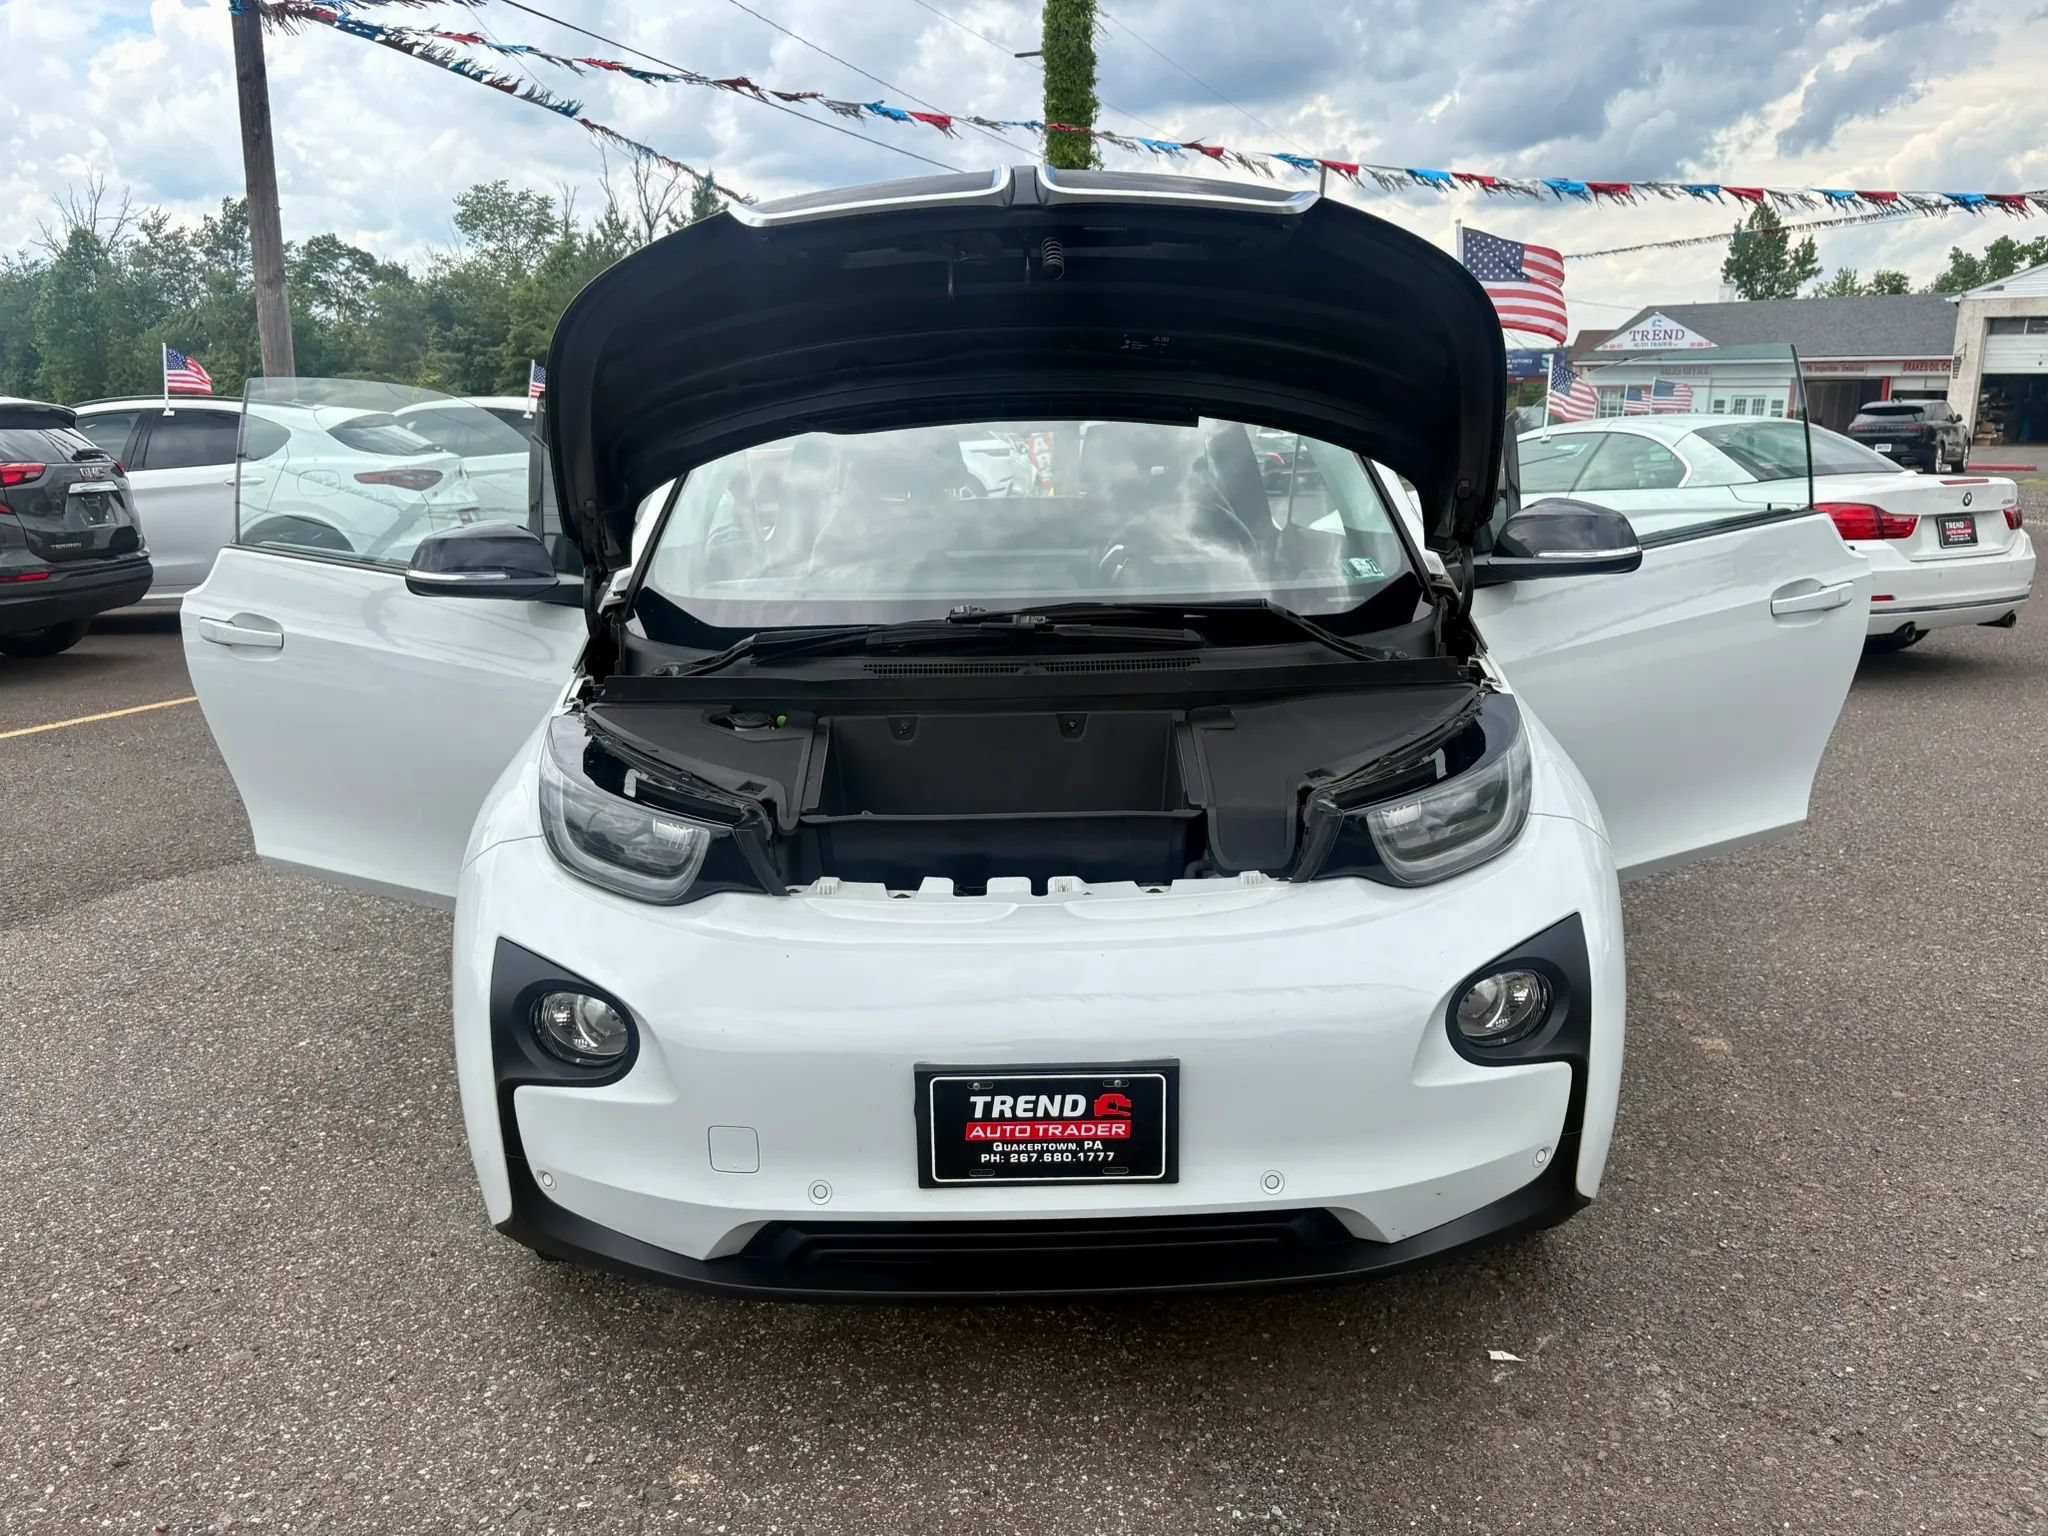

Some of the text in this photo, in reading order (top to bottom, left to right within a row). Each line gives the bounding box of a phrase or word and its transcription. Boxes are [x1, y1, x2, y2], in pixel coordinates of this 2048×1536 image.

[1629, 328, 1685, 342] TREND
[1903, 362, 1928, 372] BRAKES
[1929, 362, 1940, 371] OIL
[80, 467, 104, 477] GMC
[1945, 521, 1964, 529] TREND
[969, 1094, 1087, 1119] TREND
[969, 1123, 1126, 1138] AUTO TRADER
[1084, 1140, 1103, 1150] PA
[981, 1151, 1115, 1163] PH: 267.680.1777
